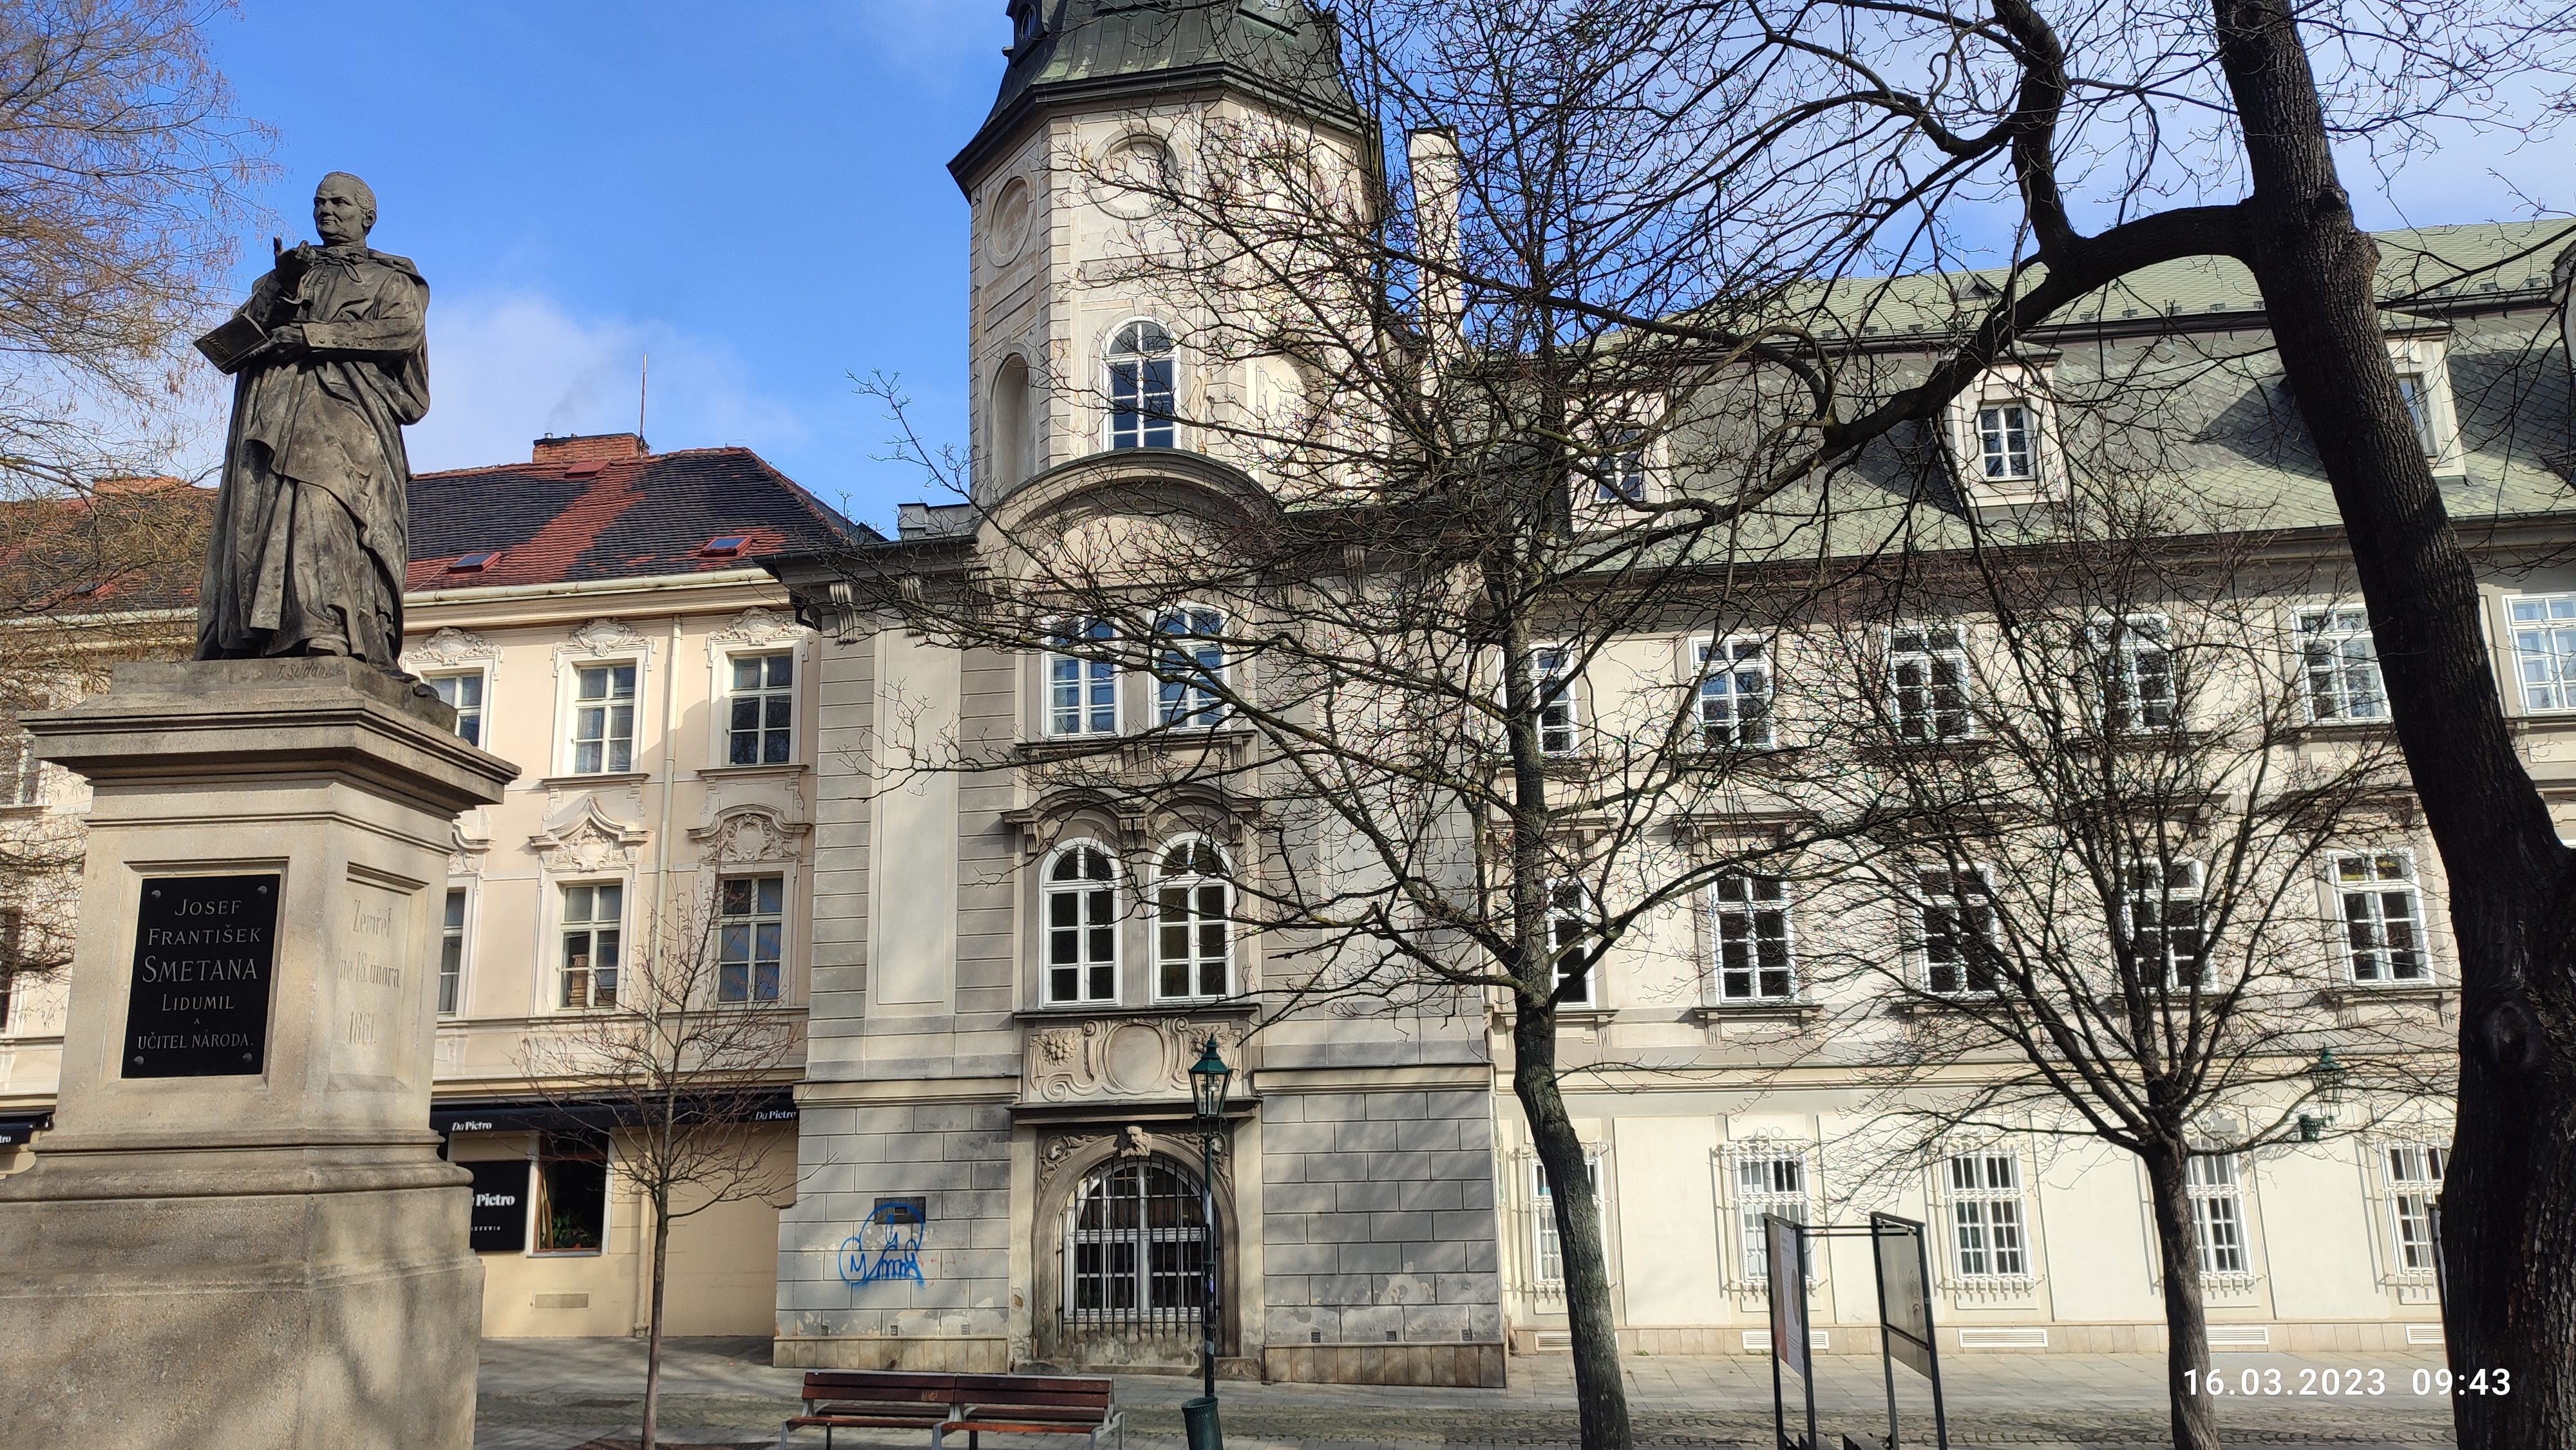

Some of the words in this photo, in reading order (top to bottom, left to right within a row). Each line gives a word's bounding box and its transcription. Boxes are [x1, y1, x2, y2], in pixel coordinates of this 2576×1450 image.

[175, 899, 242, 916] JOSEF
[147, 924, 262, 946] FRANTIŠEK
[142, 955, 258, 983] SMETANA
[162, 993, 235, 1012] LIDUMIL
[138, 1031, 187, 1050] UČITEL
[192, 1029, 254, 1048] NÁRODA.
[755, 1111, 768, 1120] Da
[768, 1109, 796, 1120] Pietro
[451, 1122, 465, 1131] Da
[465, 1121, 492, 1131] Pietro
[475, 1193, 515, 1207] Pietro
